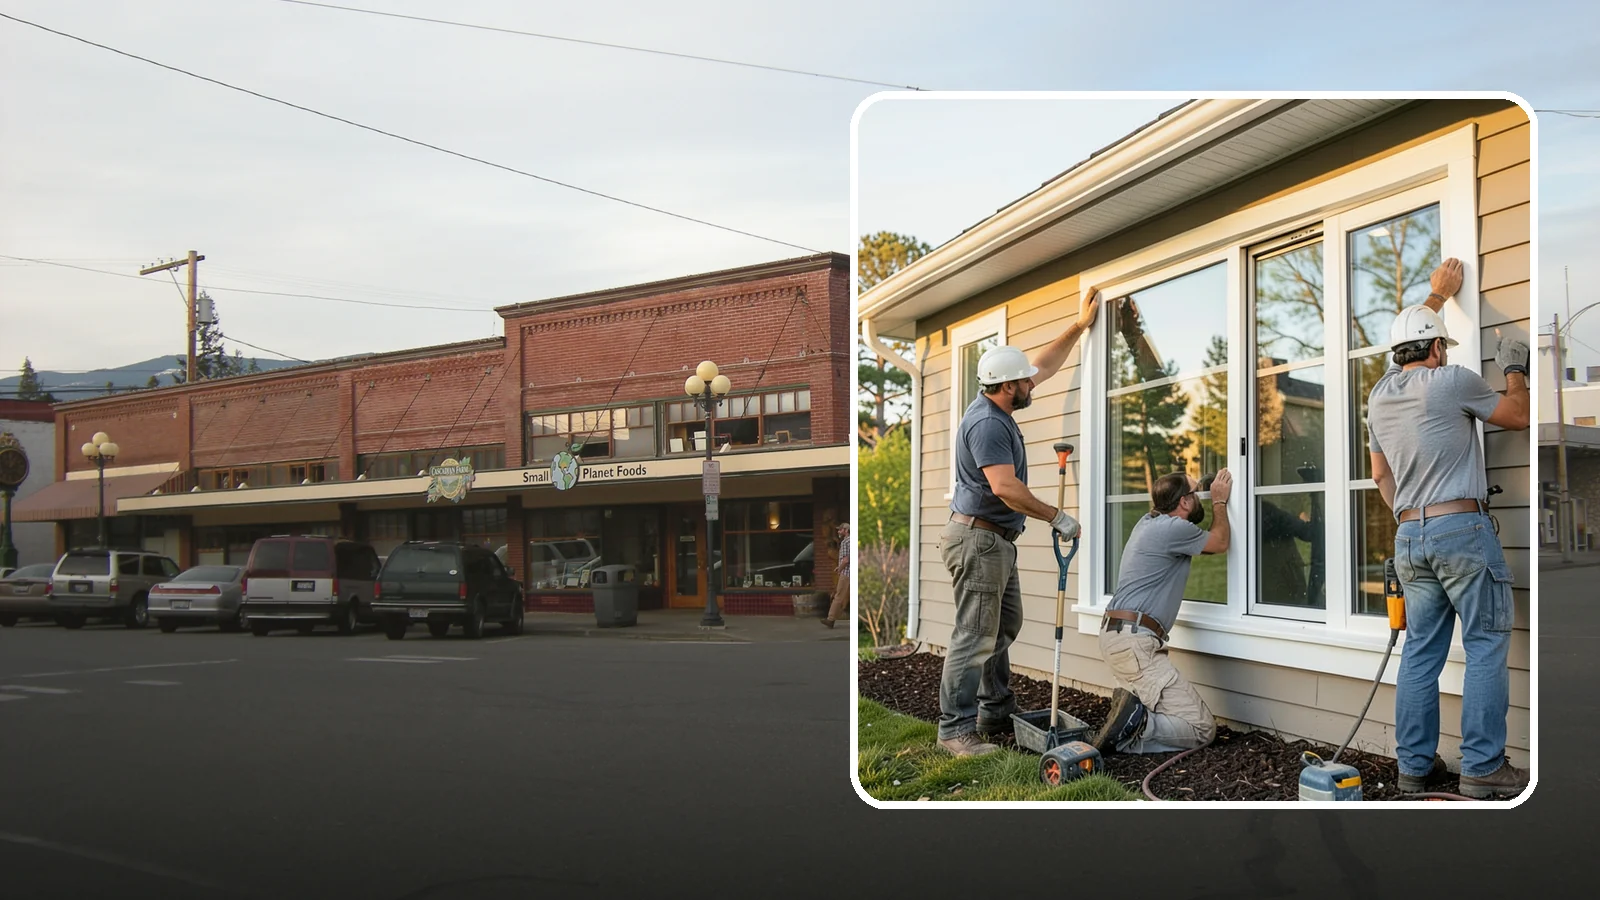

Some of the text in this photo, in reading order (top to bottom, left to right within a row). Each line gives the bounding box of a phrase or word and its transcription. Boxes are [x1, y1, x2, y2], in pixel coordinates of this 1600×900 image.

[523, 464, 647, 483] Small Planet Foods
